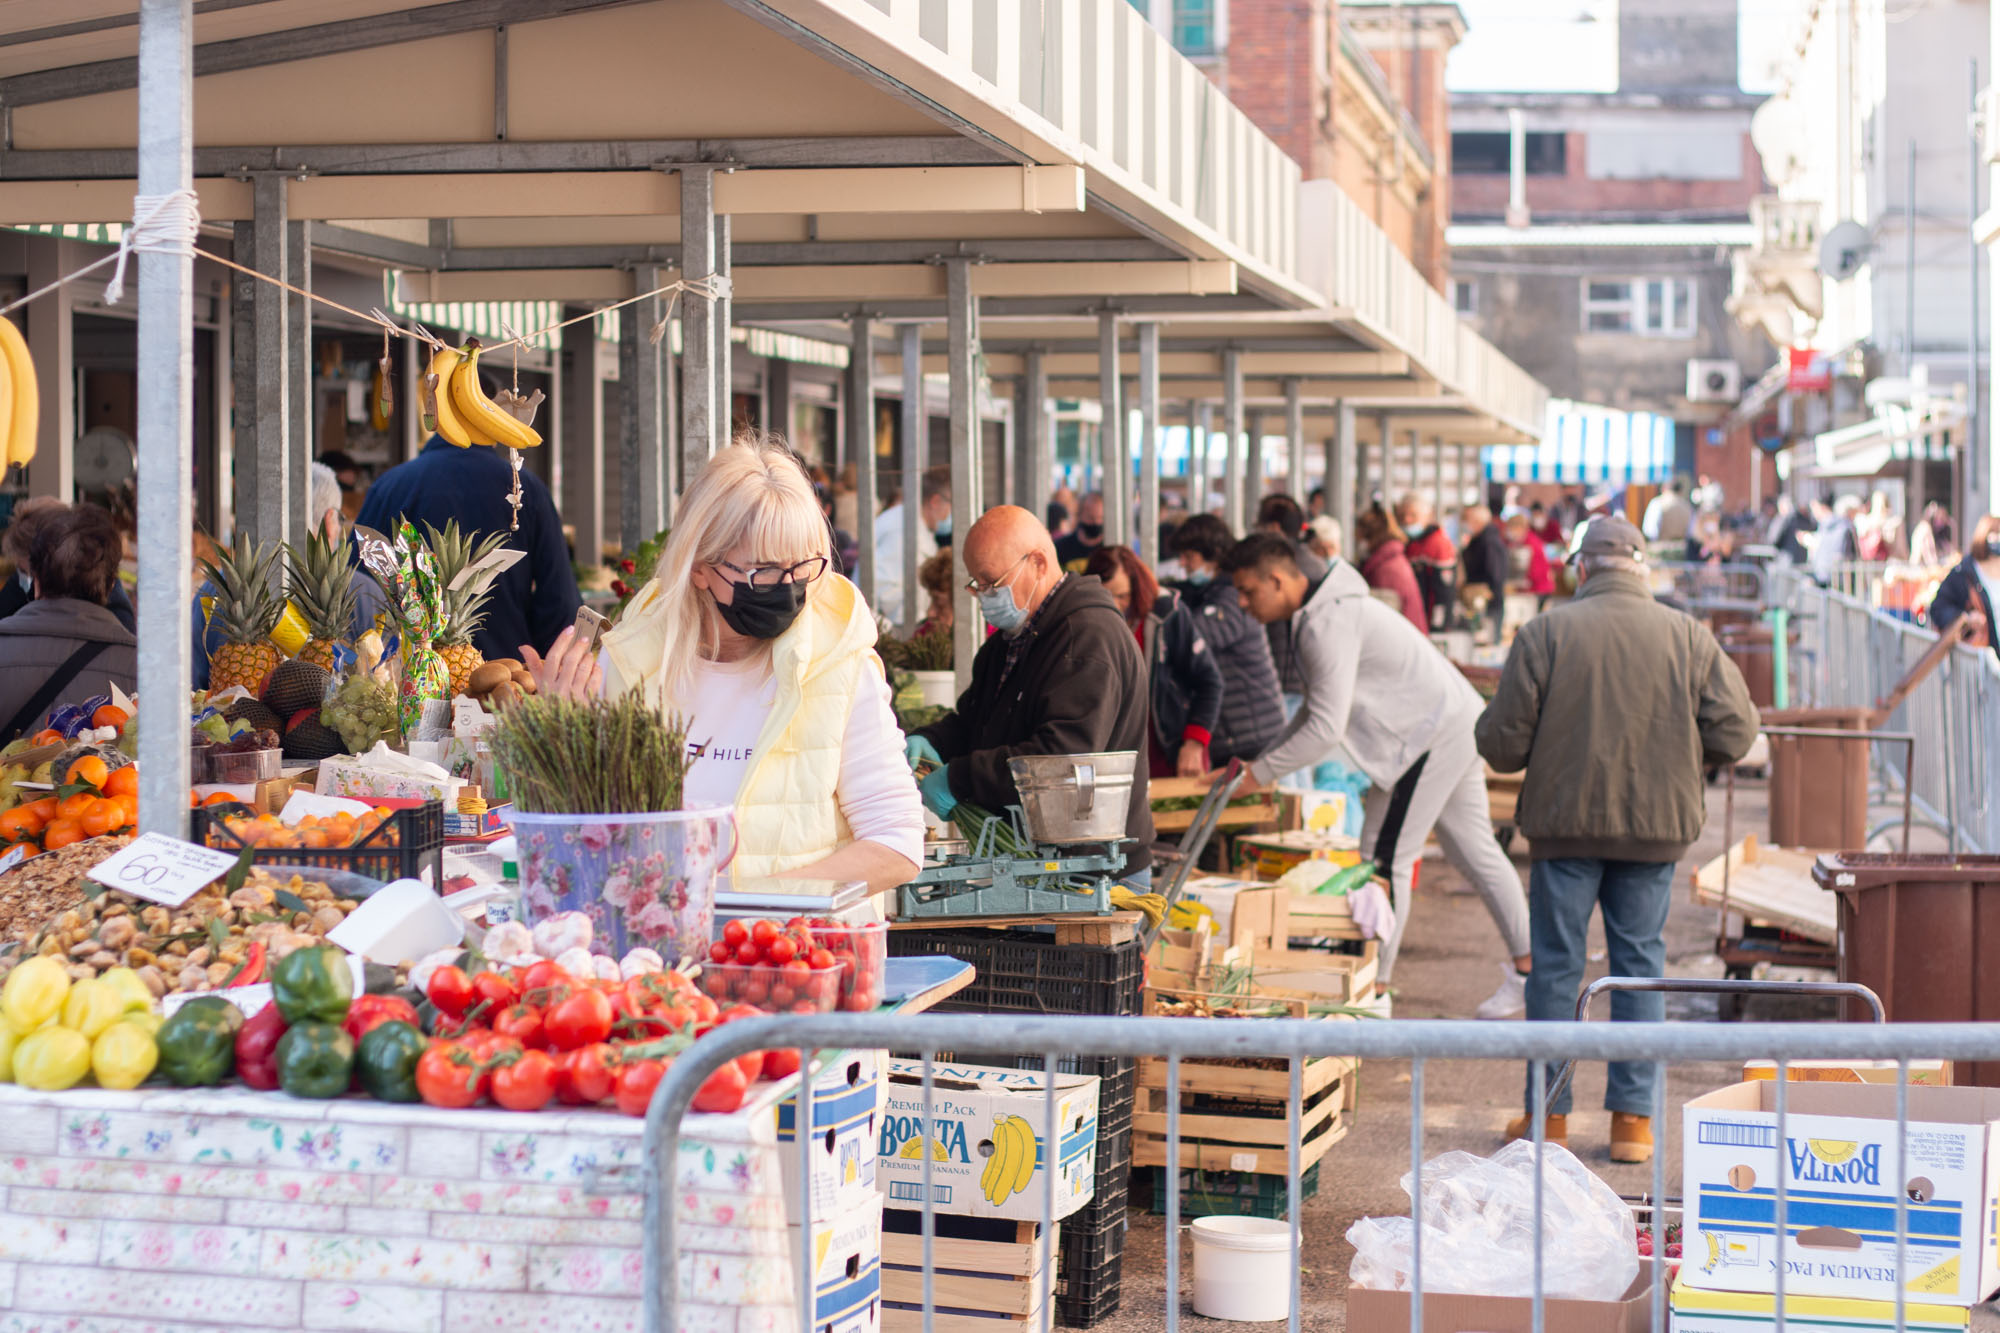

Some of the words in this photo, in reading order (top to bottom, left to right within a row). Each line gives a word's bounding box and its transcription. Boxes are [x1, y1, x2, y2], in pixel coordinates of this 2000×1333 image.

[119, 854, 168, 885] 60
[943, 1101, 976, 1116] PACK
[877, 1114, 972, 1163] BONITA
[880, 1158, 920, 1171] PREMIUM
[1784, 1138, 1882, 1186] BONITA
[1820, 1264, 1896, 1282] REMIUM
